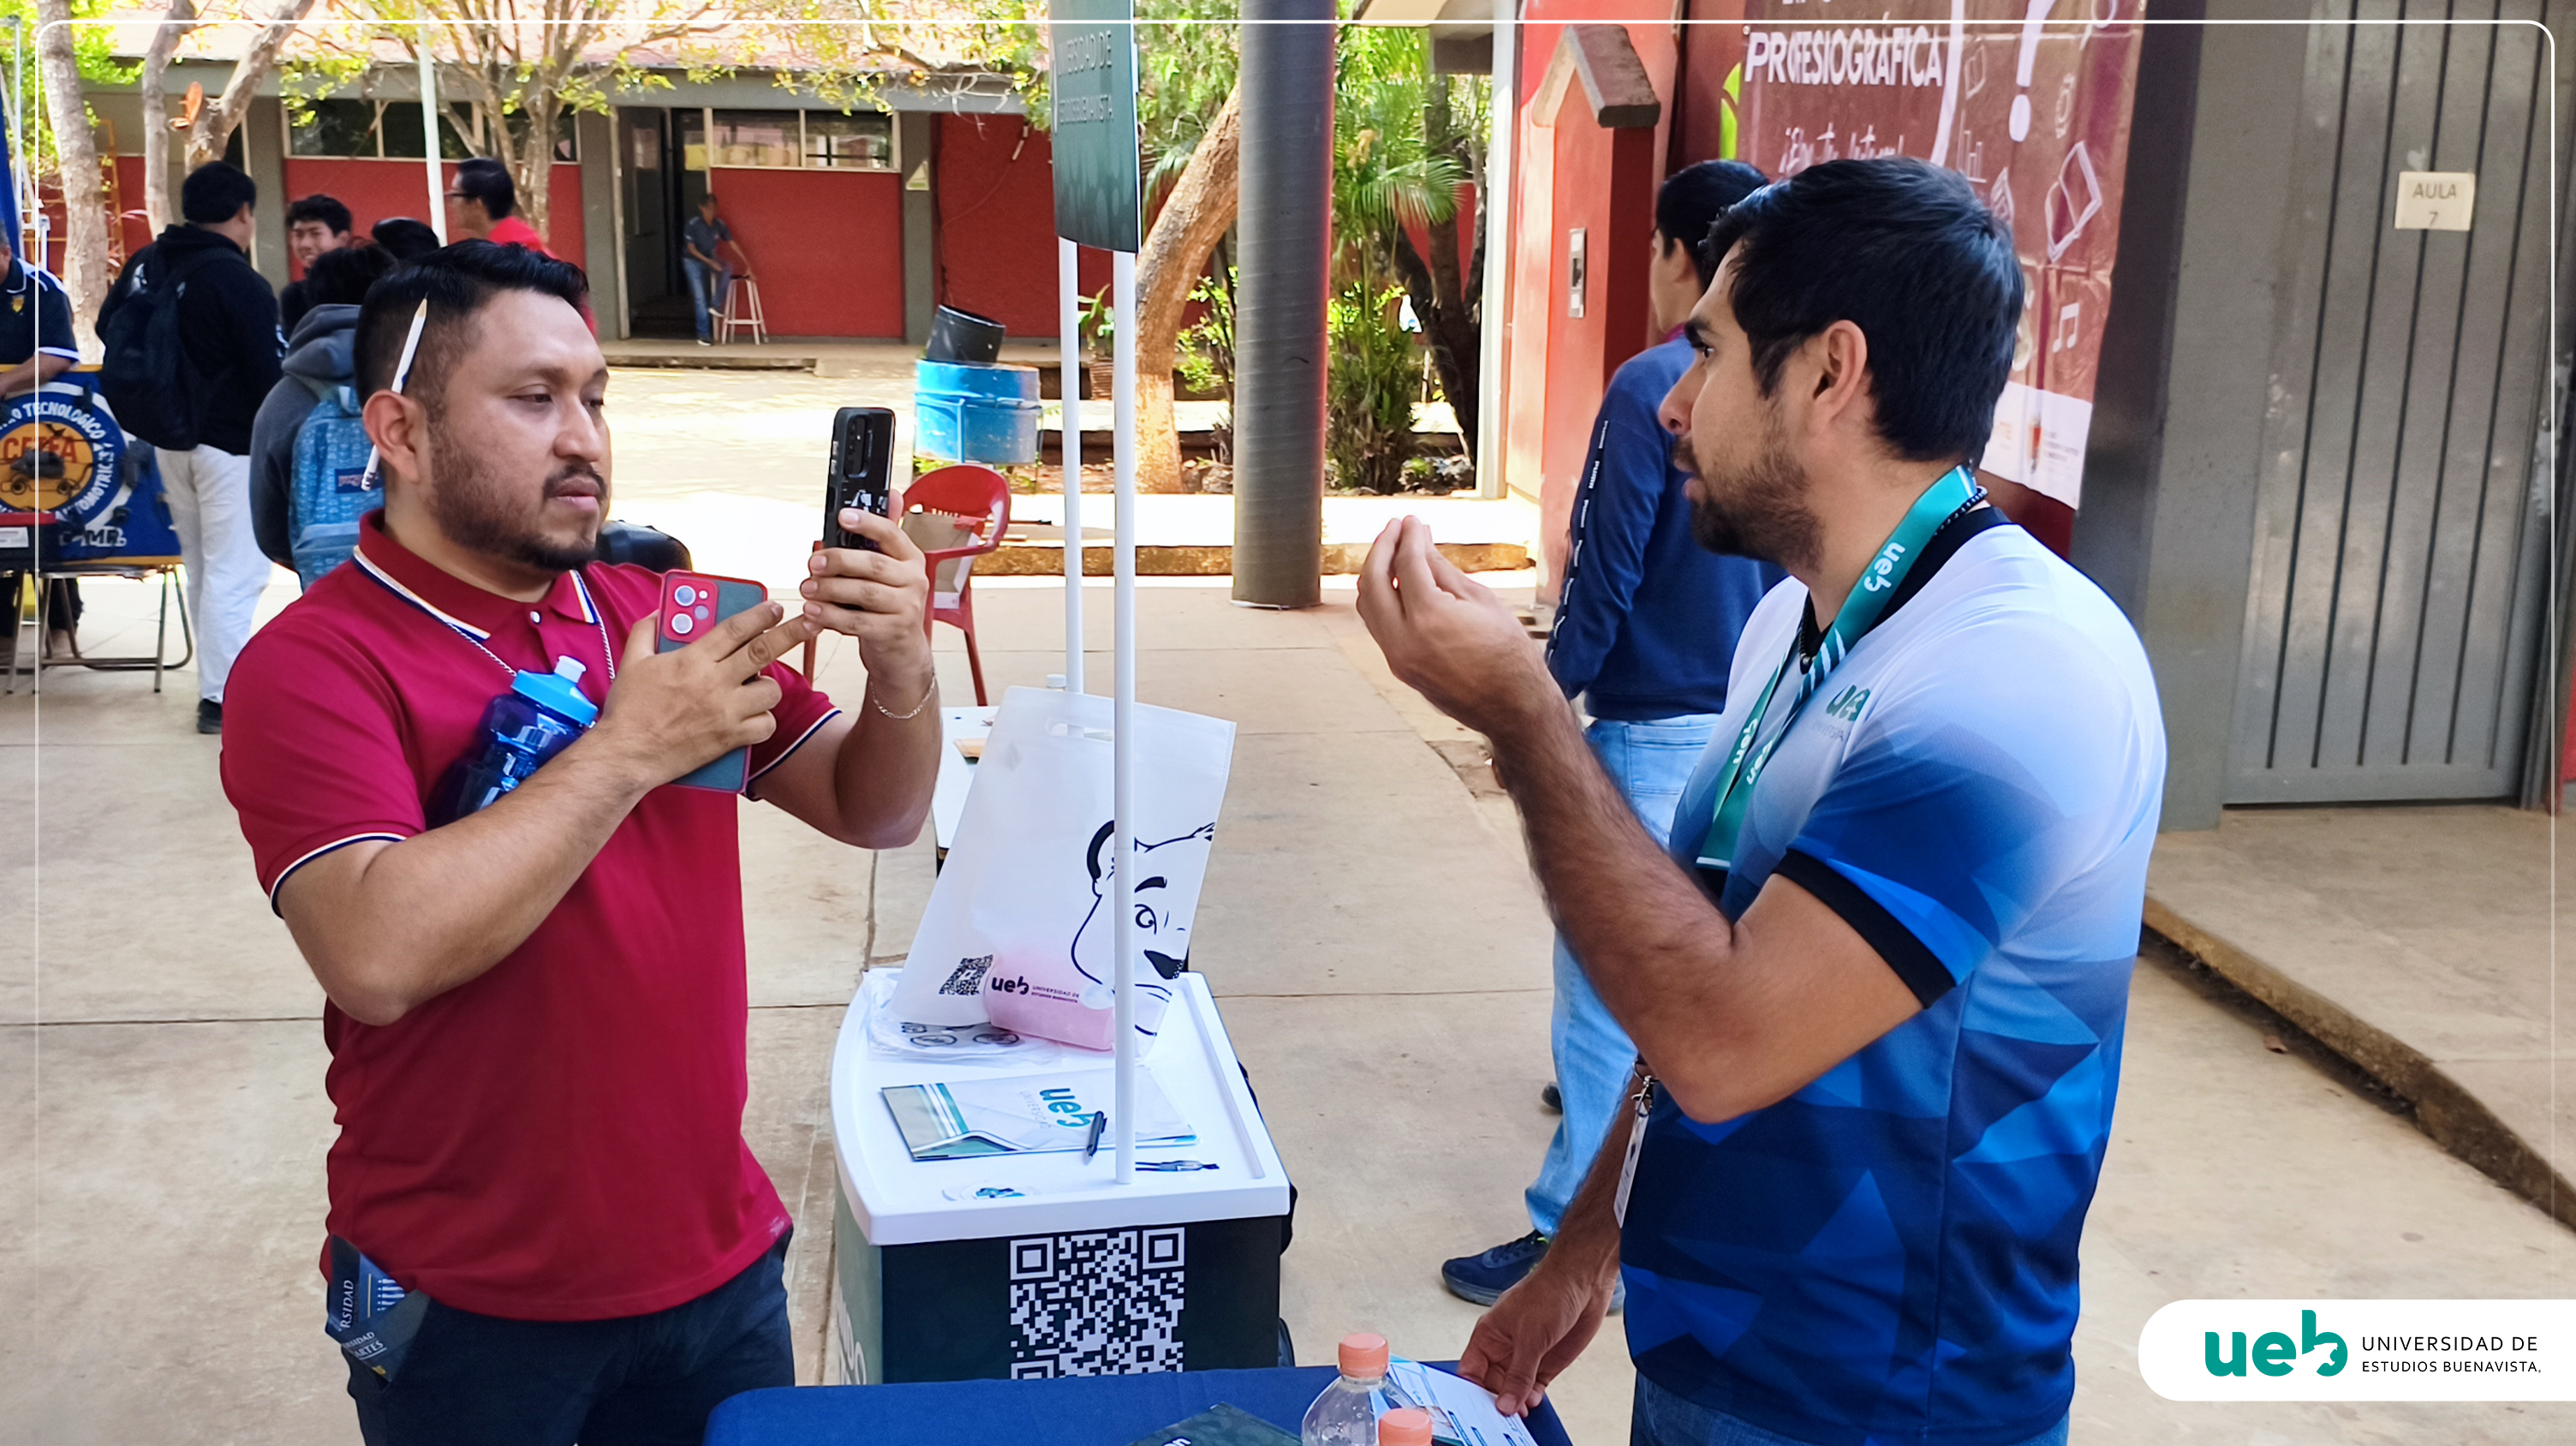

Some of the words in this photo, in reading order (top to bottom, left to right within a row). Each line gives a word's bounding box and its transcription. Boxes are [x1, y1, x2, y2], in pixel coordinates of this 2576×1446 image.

[1099, 30, 1112, 68] DE
[2412, 182, 2456, 199] AULA
[2429, 211, 2439, 227] 7
[1863, 542, 1906, 592] ueb
[992, 976, 1029, 995] ueb
[1039, 1087, 1097, 1127] ueb
